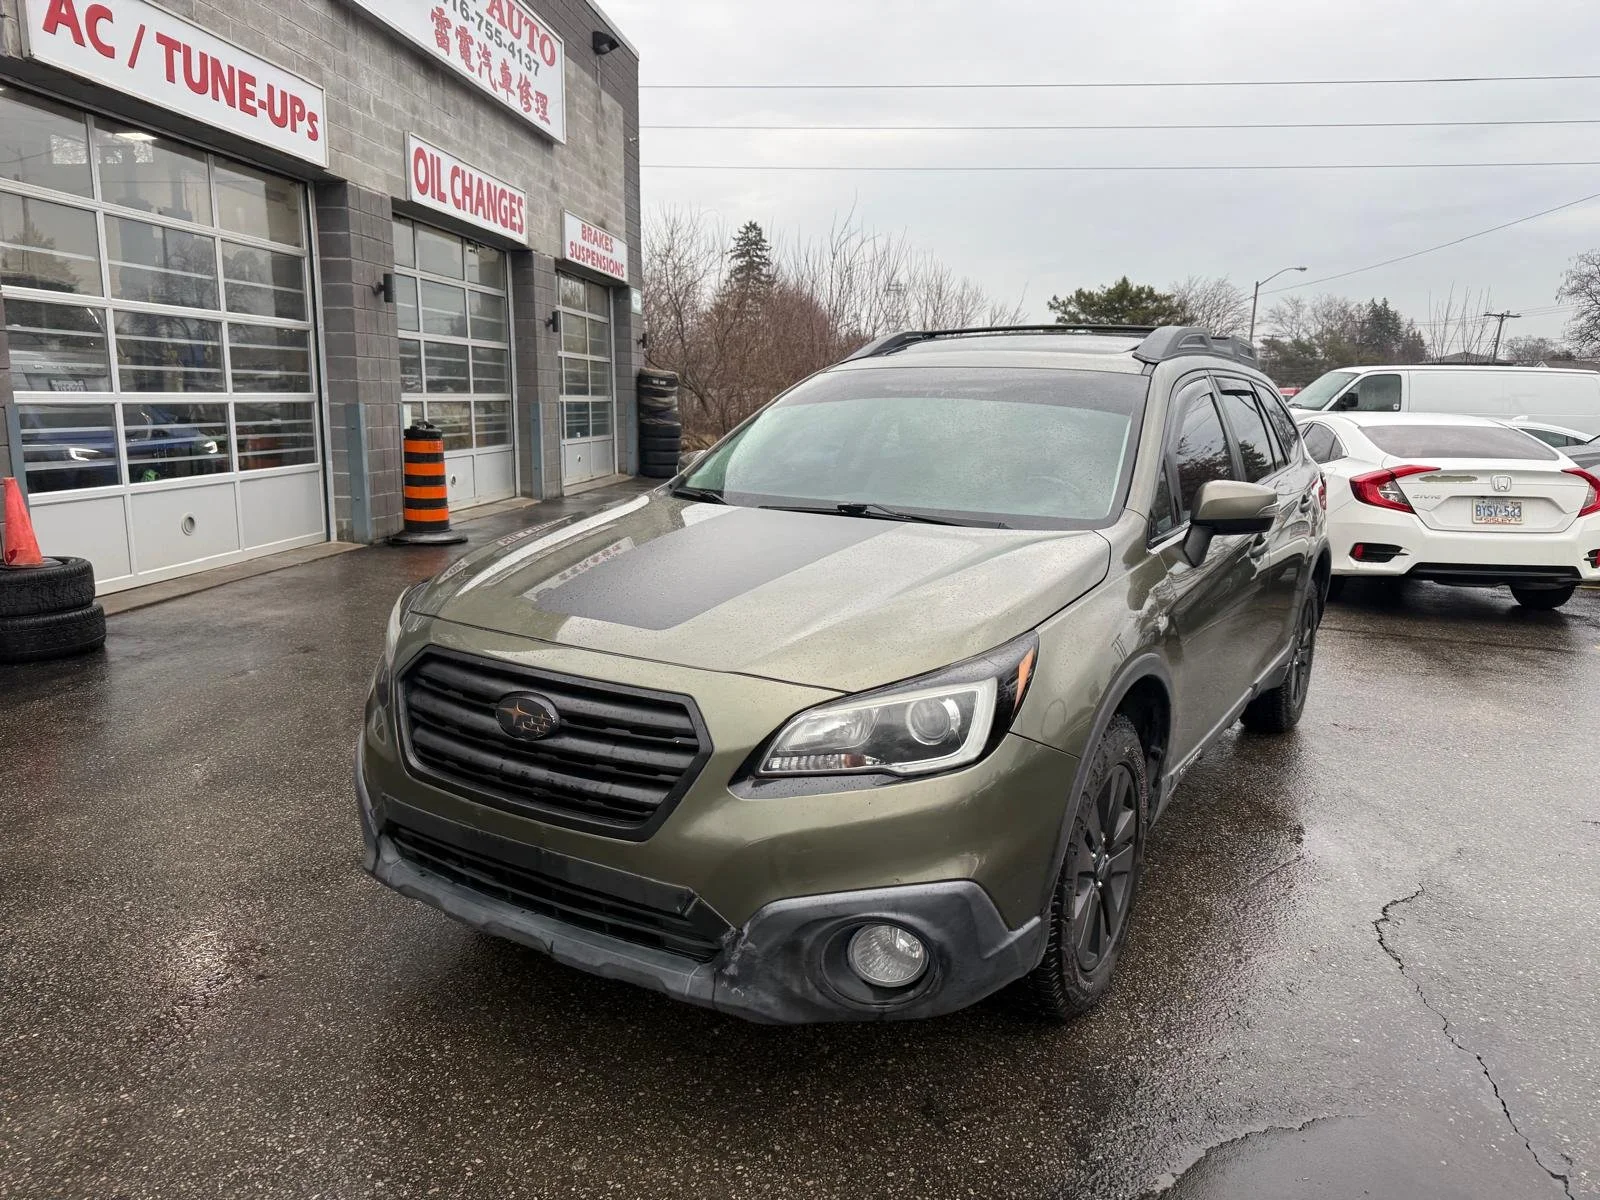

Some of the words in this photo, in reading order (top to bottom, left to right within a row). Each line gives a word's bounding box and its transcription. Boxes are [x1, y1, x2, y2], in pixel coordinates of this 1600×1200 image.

[42, 0, 116, 60] AC
[127, 23, 146, 69] /
[430, 6, 551, 125] 雷電汽車修理
[443, 0, 540, 77] 16-755-4137
[486, 0, 556, 67] AUTO
[413, 146, 447, 204] OIL
[449, 164, 524, 236] CHANGES
[569, 240, 625, 278] SUSPENSIONS
[581, 223, 614, 254] BRAKES
